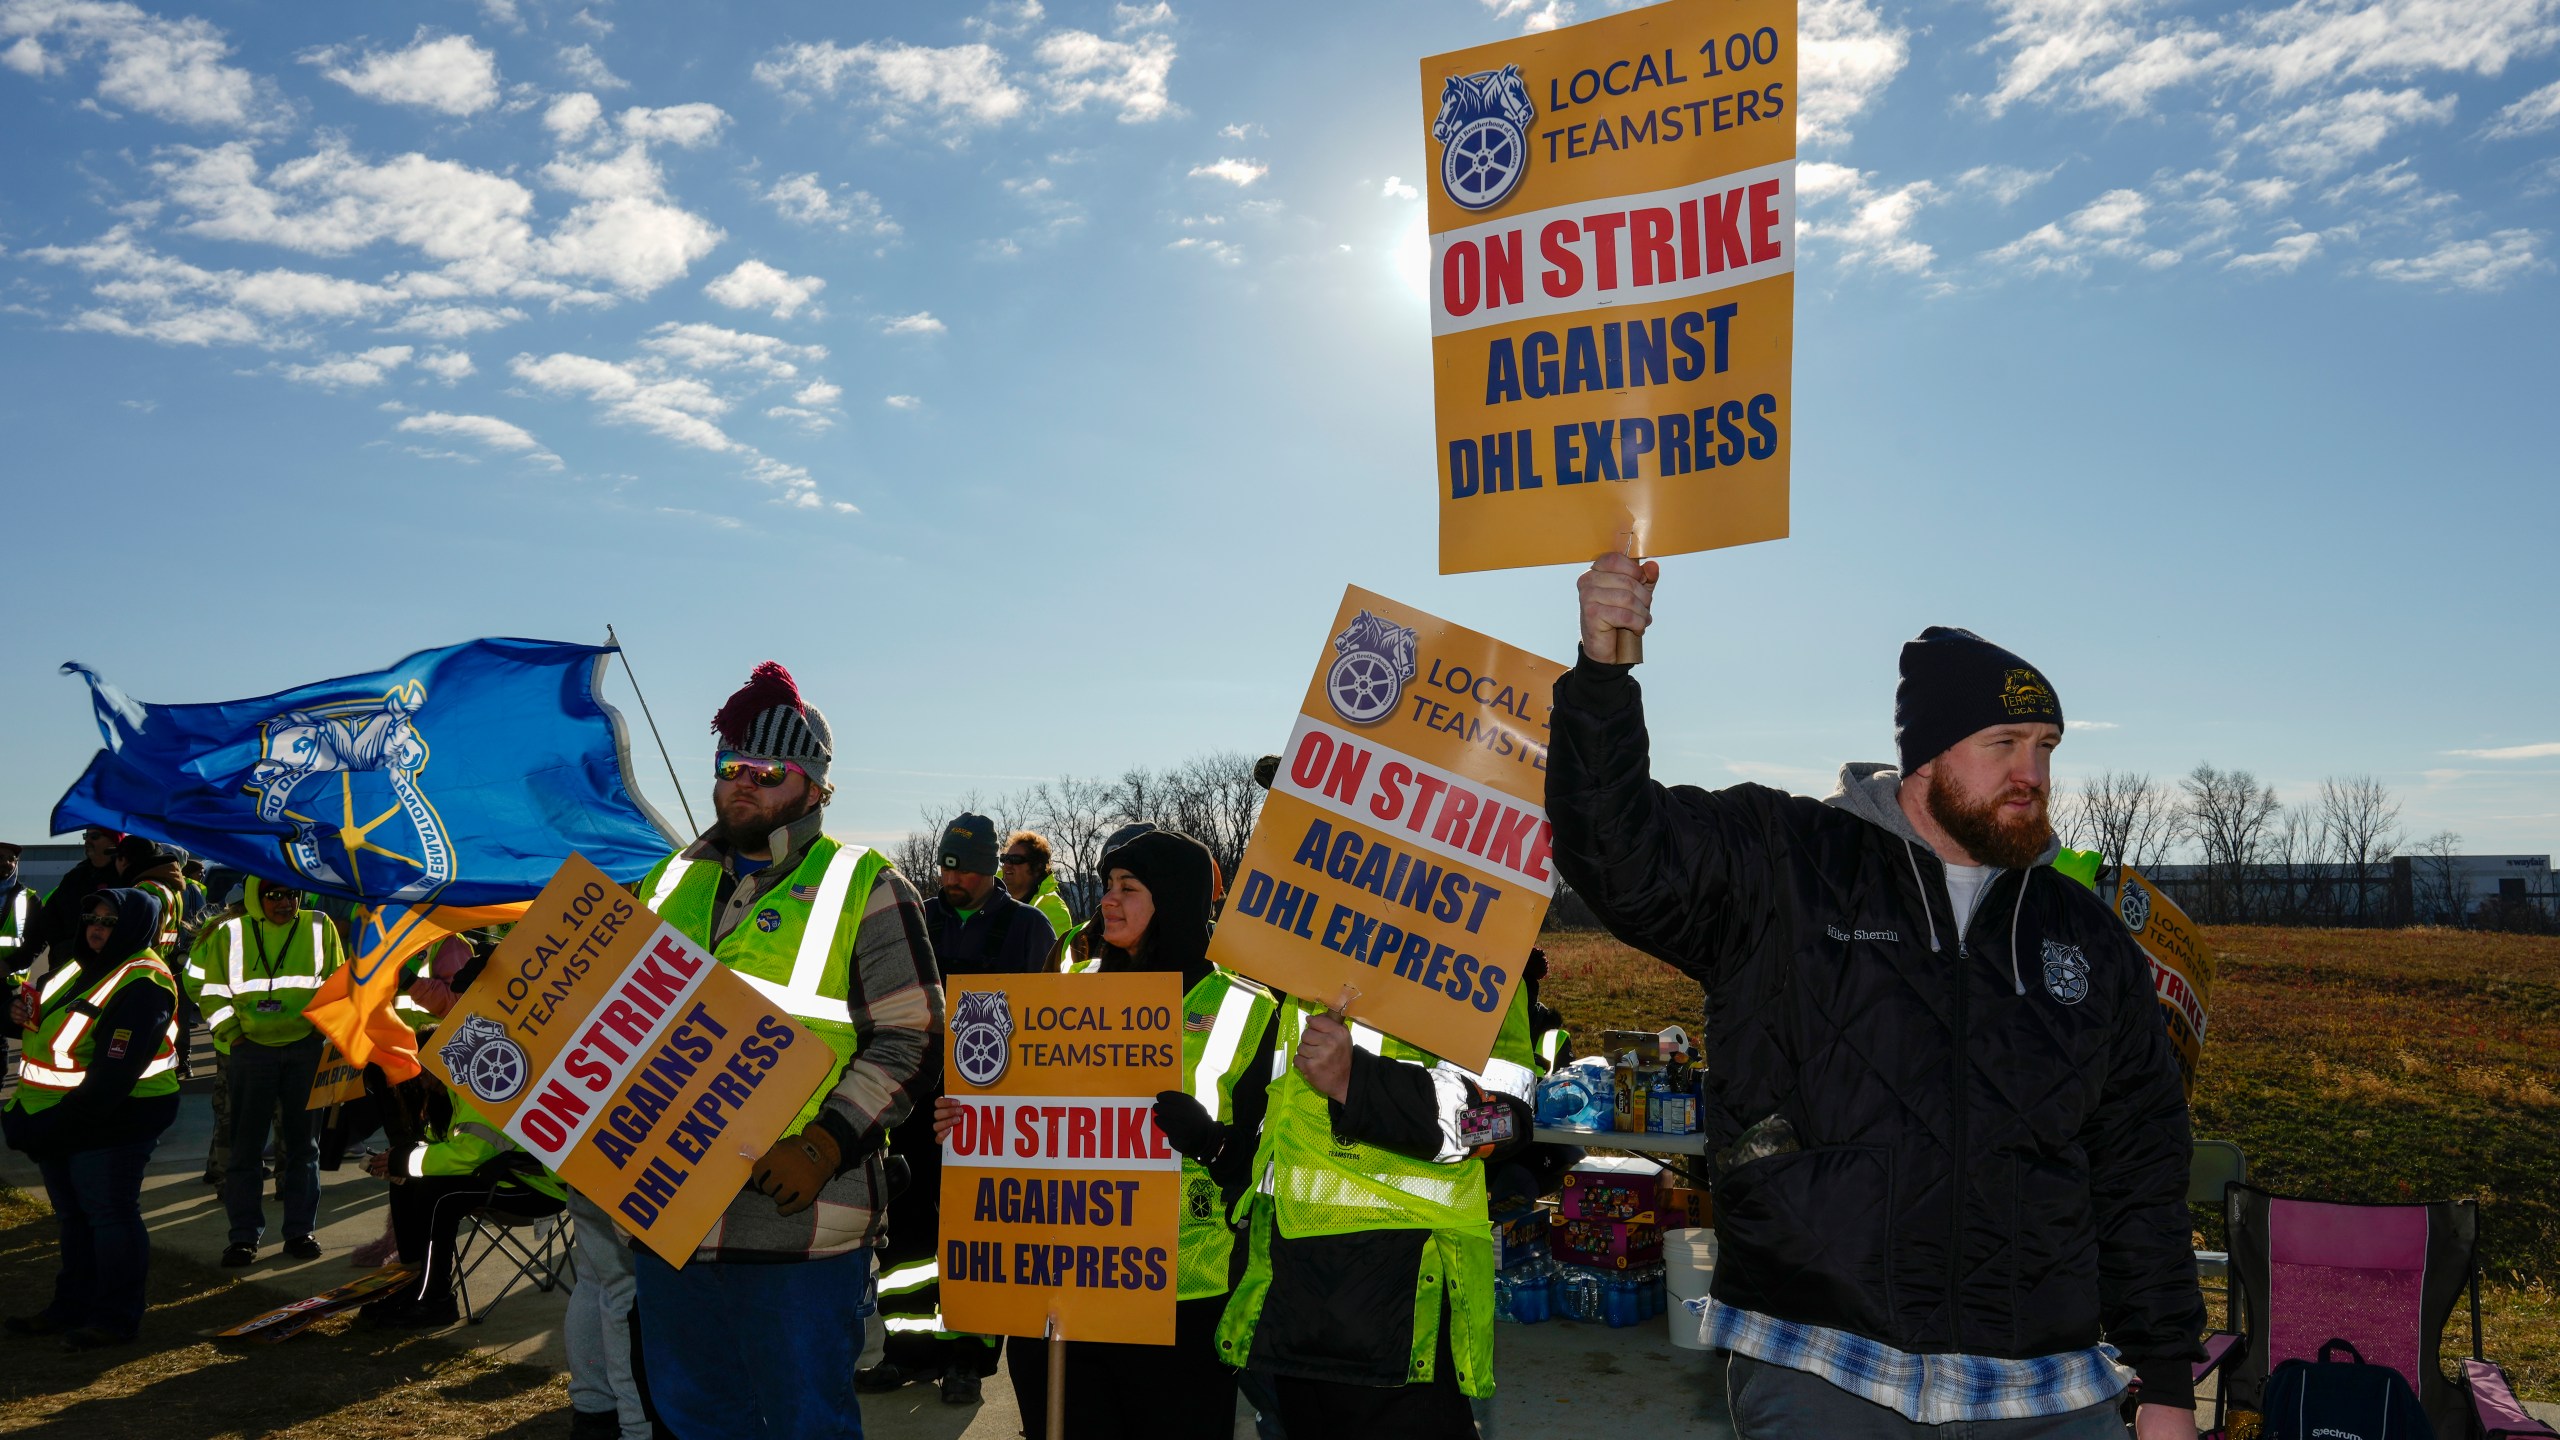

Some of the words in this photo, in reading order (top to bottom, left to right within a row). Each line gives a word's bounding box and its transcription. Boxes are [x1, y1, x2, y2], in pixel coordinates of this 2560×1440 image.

[1550, 49, 1688, 112] LOCAL
[1699, 26, 1778, 78] 100
[1448, 135, 1463, 185] International
[1463, 119, 1505, 136] Brotherhood
[1542, 82, 1784, 163] TEAMSTERS
[1442, 234, 1524, 317] ON
[1540, 178, 1780, 298] STRIKE
[1485, 302, 1738, 406] AGAINST
[1449, 428, 1542, 500] DHL
[1554, 393, 1777, 486] EXPRESS
[1356, 653, 1389, 671] Brotherhood
[1427, 658, 1531, 722] LOCAL
[1412, 695, 1548, 772] TEAMSTE
[2008, 707, 2037, 716] LOCAL
[1290, 730, 1372, 806] ON
[1369, 761, 1555, 883] STRIKE
[1293, 818, 1501, 935] AGAINST
[2513, 857, 2546, 868] wayfair
[496, 936, 569, 1016] LOCAL
[562, 881, 605, 932] 100
[517, 898, 634, 1037] TEAMSTERS
[1237, 869, 1320, 939] DHL
[1321, 904, 1507, 1013] EXPRESS
[1854, 929, 1899, 942] Sherrill
[2150, 926, 2209, 999] TEAMSTERS
[2154, 911, 2196, 957] LOCAL
[2196, 953, 2212, 982] 100
[520, 1078, 590, 1153] ON
[563, 934, 703, 1092] STRIKE
[1019, 1043, 1174, 1067] TEAMSTERS
[1024, 1006, 1112, 1031] LOCAL
[1121, 1006, 1171, 1031] 100
[592, 1001, 728, 1170] AGAINST
[1461, 1110, 1477, 1119] CVG
[618, 1156, 688, 1231] DHL
[666, 1014, 794, 1166] EXPRESS
[952, 1104, 1005, 1156] ON
[1014, 1105, 1172, 1159] STRIKE
[1328, 1150, 1360, 1160] TEAMSTERS
[974, 1177, 1140, 1226] AGAINST
[947, 1239, 1006, 1284] DHL
[1014, 1243, 1167, 1290] EXPRESS
